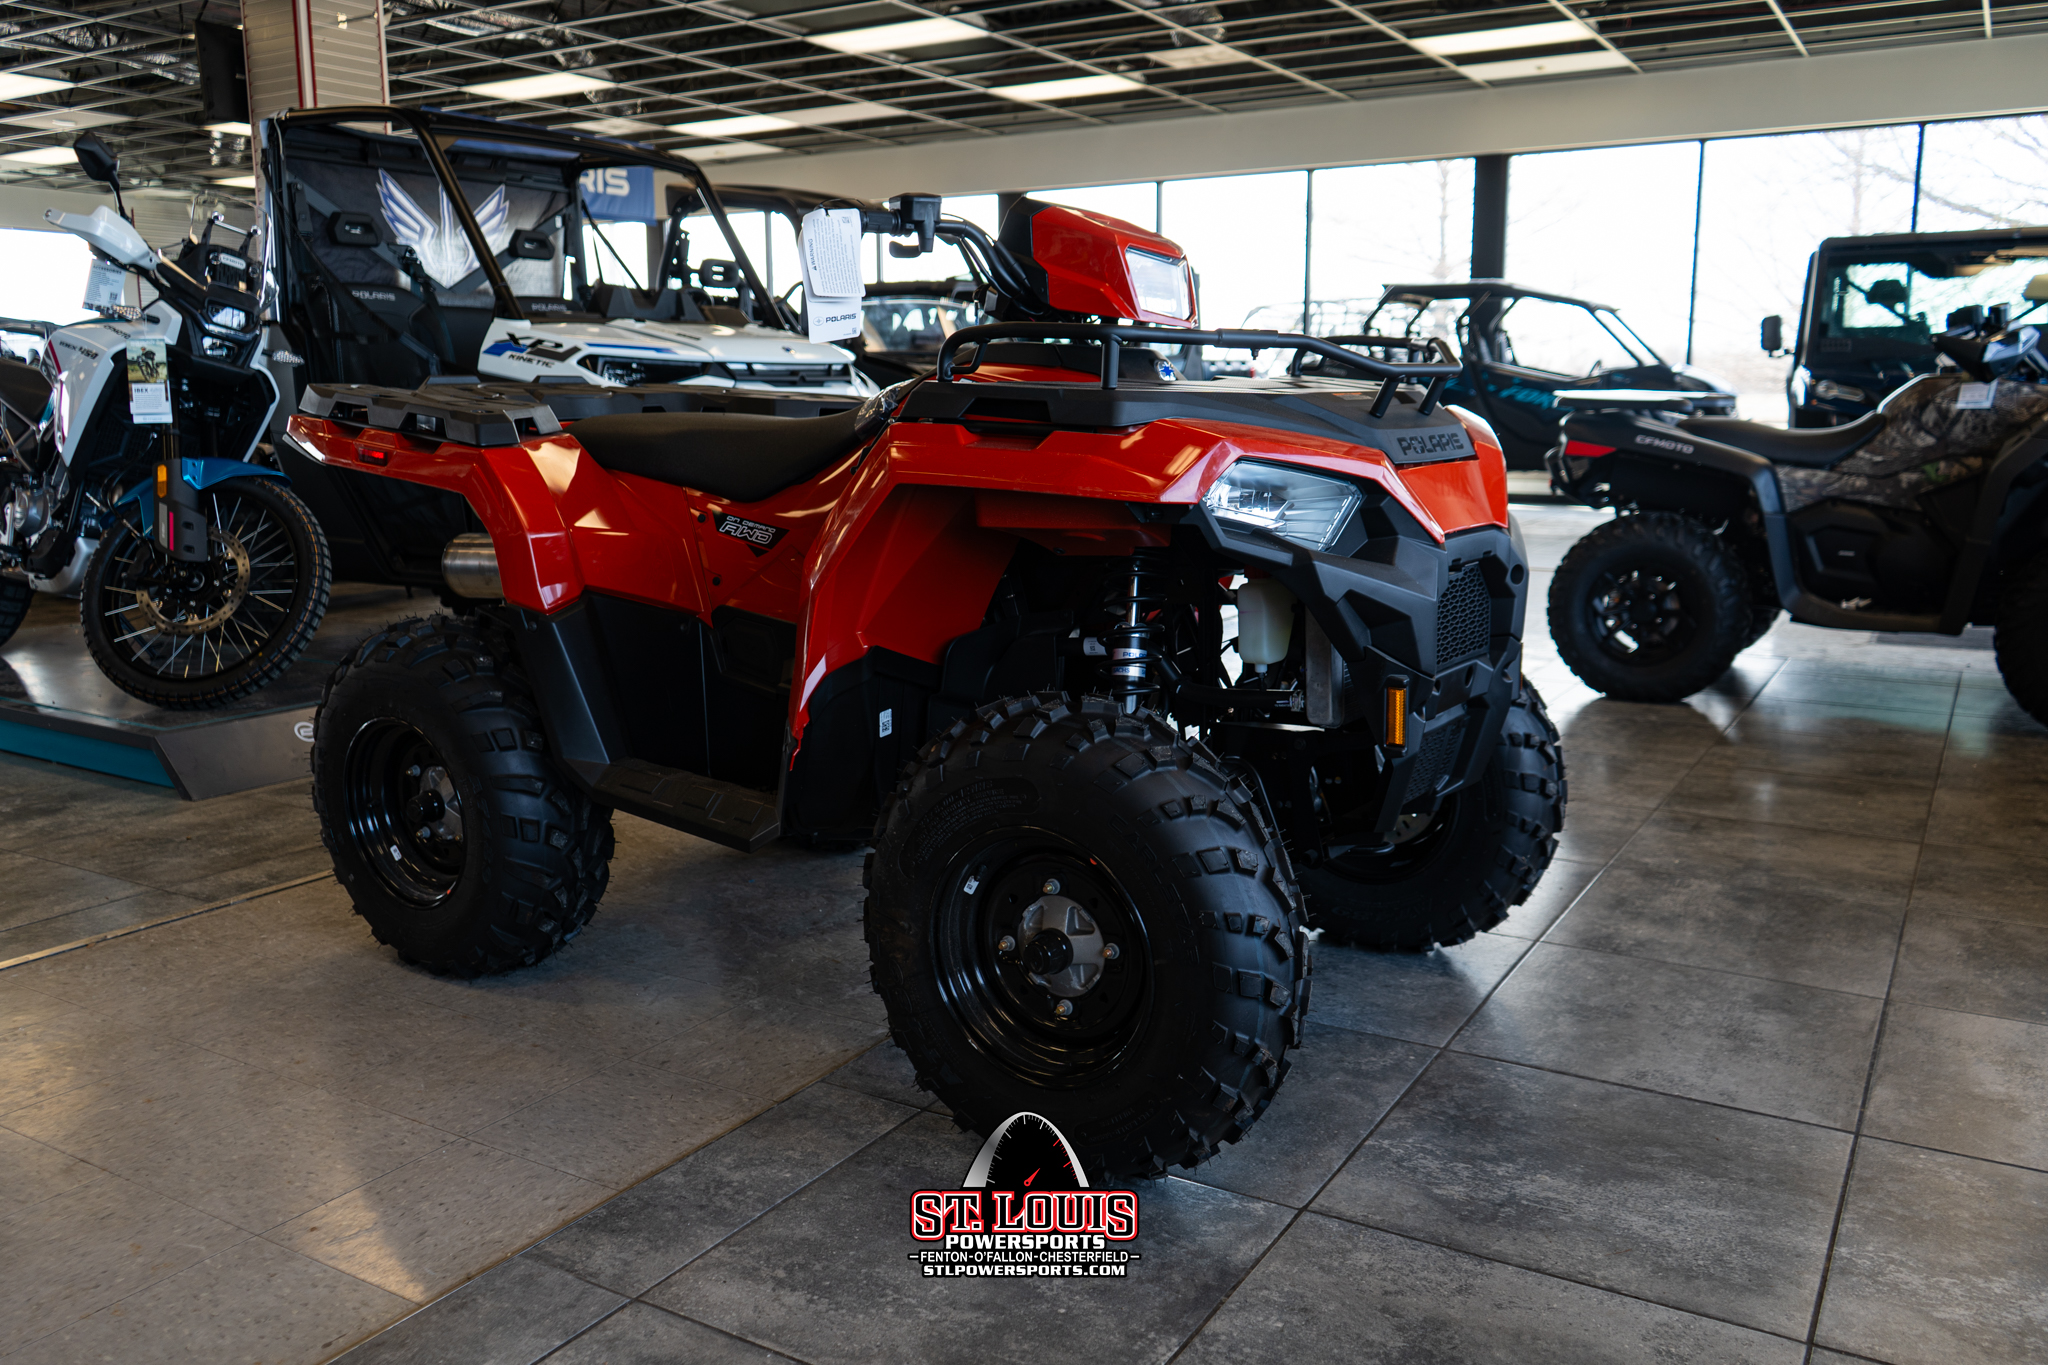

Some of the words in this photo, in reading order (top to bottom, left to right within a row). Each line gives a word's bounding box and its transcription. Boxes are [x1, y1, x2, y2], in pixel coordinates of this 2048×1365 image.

[808, 239, 816, 266] WARNING
[352, 290, 396, 301] POLARIS
[531, 302, 568, 312] POLARIS
[825, 313, 857, 324] POLARIS
[78, 346, 99, 360] 450
[508, 353, 556, 369] KINETIC
[1396, 432, 1465, 456] POLARIS
[1635, 434, 1695, 455] CFMOTO
[726, 515, 741, 523] ON
[742, 520, 776, 533] DEMAND
[719, 521, 773, 545] AWD
